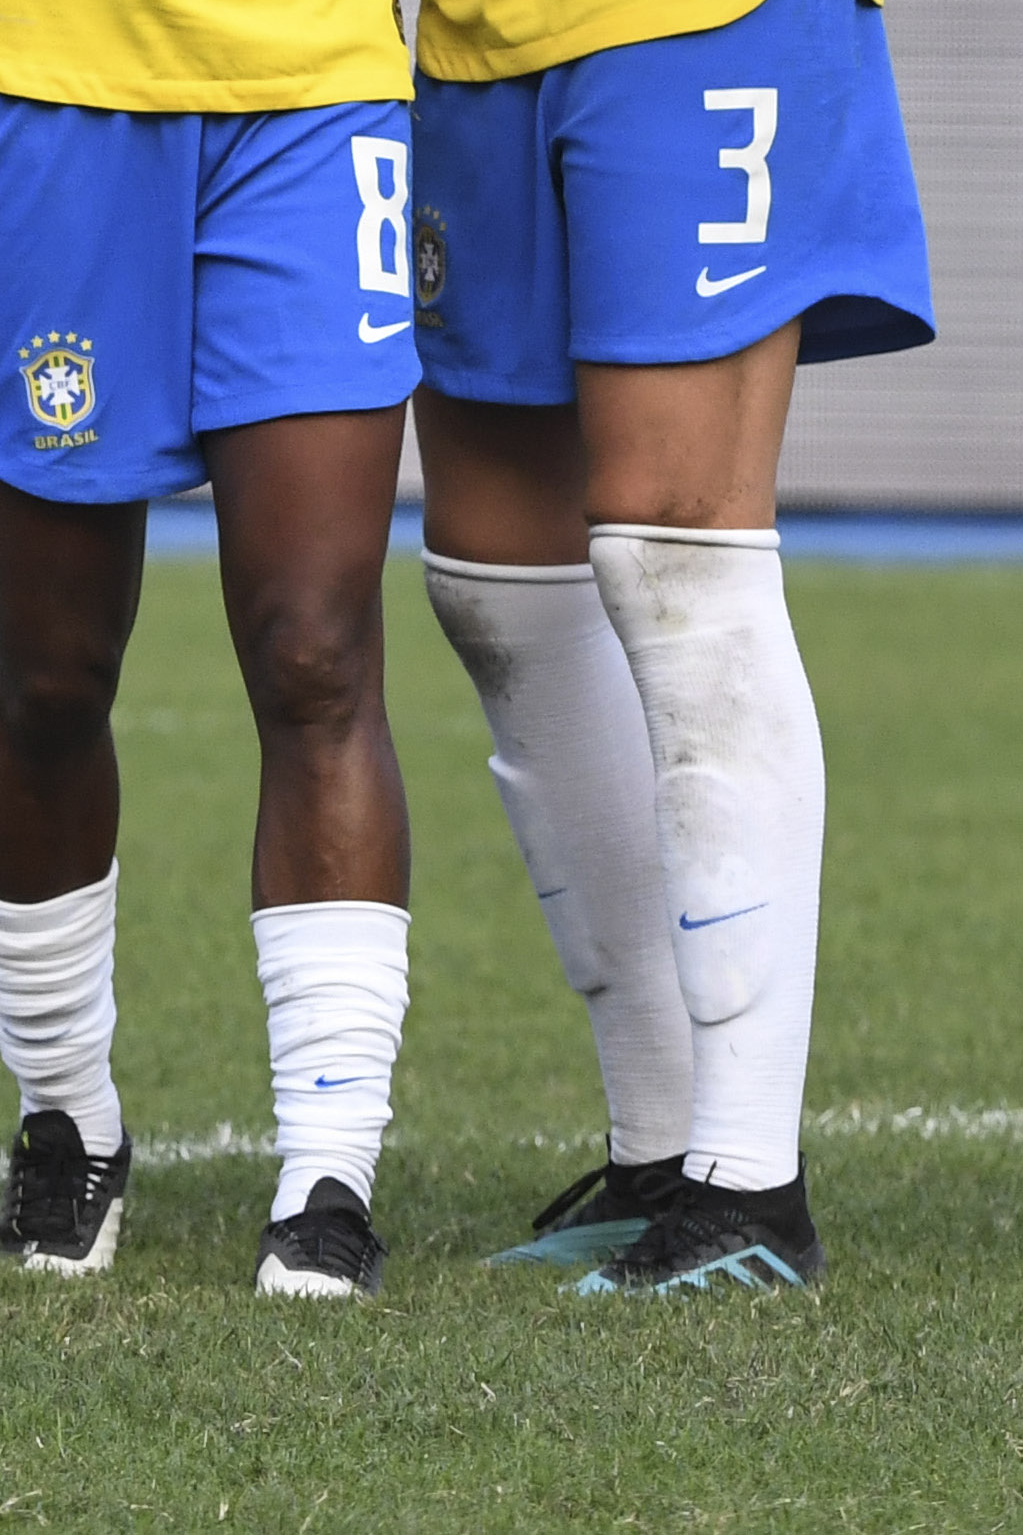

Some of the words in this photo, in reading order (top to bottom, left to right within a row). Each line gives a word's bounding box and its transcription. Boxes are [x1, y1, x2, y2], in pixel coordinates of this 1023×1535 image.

[698, 88, 778, 243] 3
[351, 135, 409, 298] 8
[49, 380, 70, 391] CBF
[34, 428, 99, 449] BRASIL
